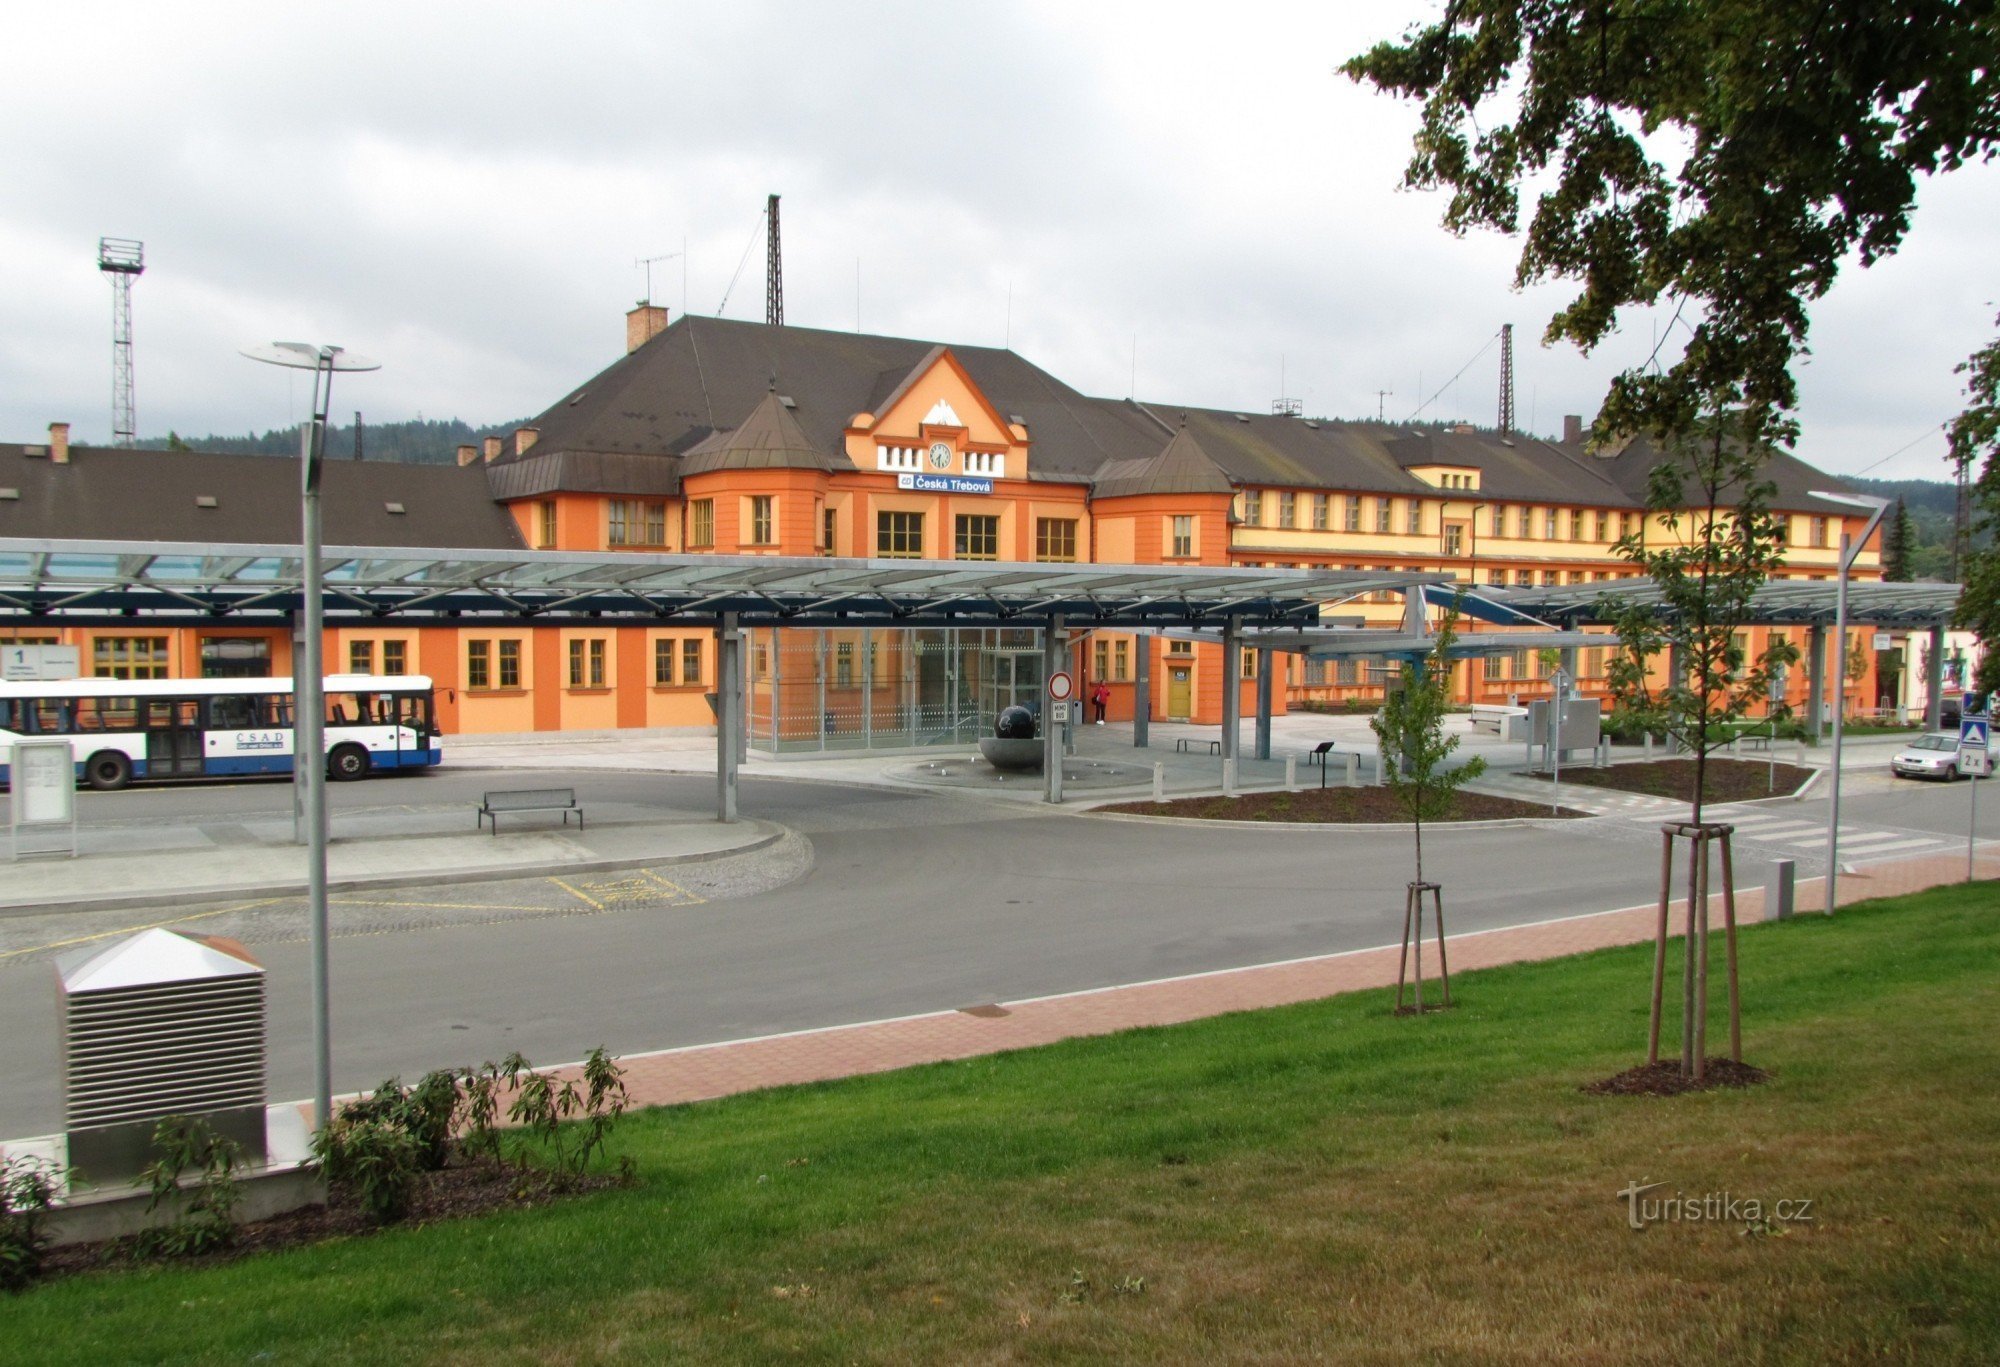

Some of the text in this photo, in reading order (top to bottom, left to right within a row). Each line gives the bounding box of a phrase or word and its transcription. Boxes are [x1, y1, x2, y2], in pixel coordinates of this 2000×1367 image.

[916, 475, 948, 489] Česká
[950, 479, 990, 492] Třebová
[14, 650, 24, 664] 1
[1965, 755, 1971, 766] 2
